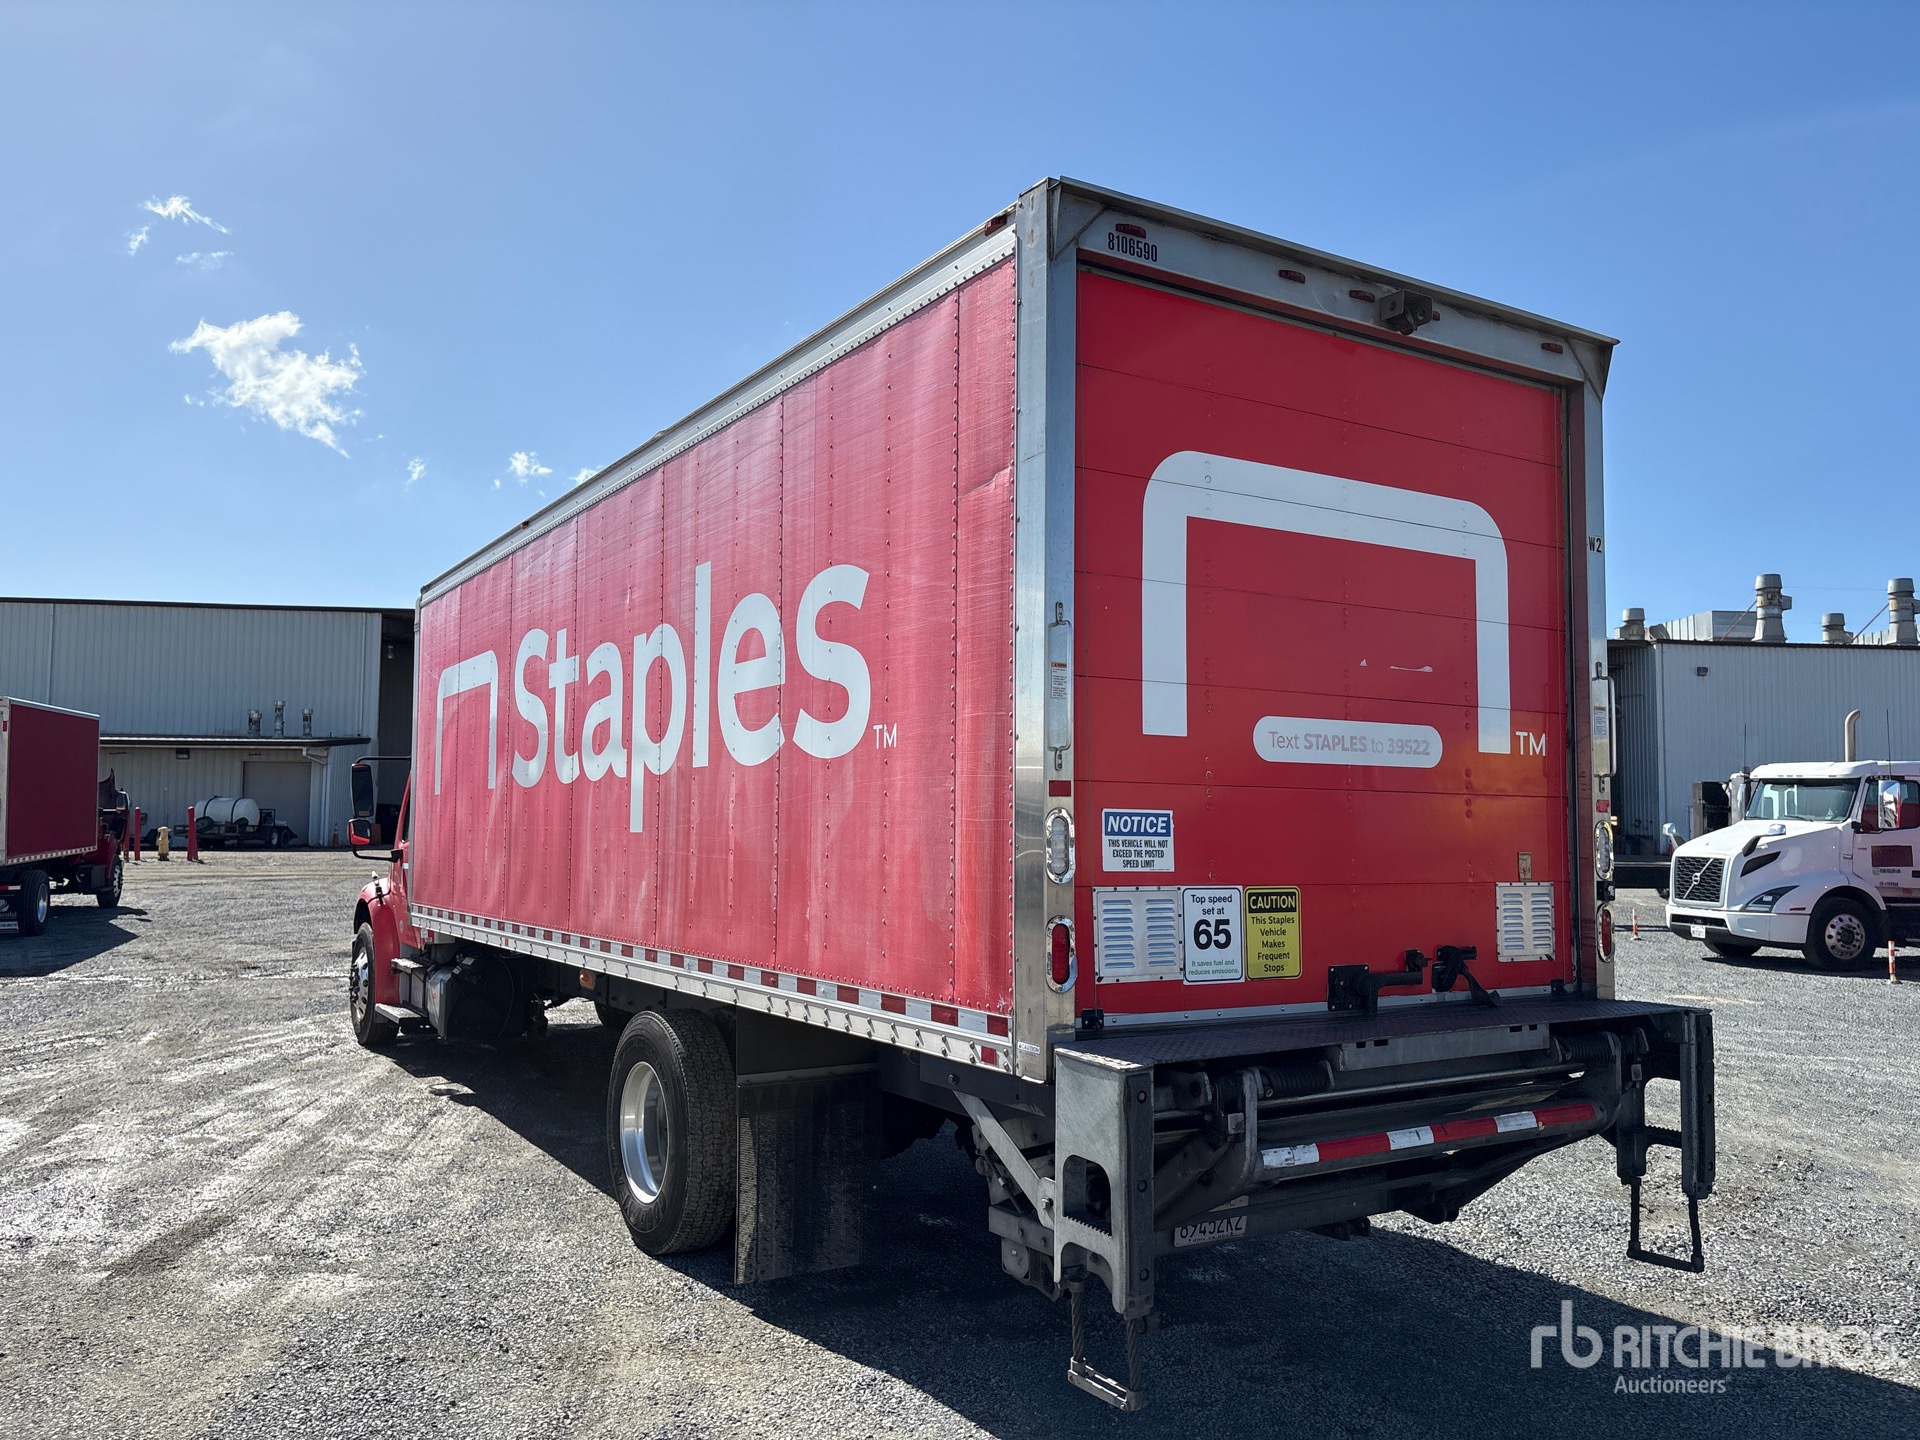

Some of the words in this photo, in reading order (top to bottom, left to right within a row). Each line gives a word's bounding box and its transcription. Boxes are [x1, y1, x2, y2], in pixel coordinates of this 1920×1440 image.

[1108, 232, 1157, 262] 8106590
[512, 561, 871, 833] Staples
[873, 723, 897, 750] TM
[1268, 731, 1299, 749] Text
[1304, 733, 1366, 752] STAPLES
[1371, 739, 1384, 753] to
[1387, 738, 1430, 755] 39522
[1515, 731, 1546, 757] TM
[1108, 816, 1167, 833] NOTICE
[1108, 839, 1120, 847] THIS
[1122, 839, 1142, 847] VEHICLE
[1144, 840, 1156, 848] WILL
[1158, 840, 1168, 848] NOT
[1145, 850, 1164, 858] POSTED
[1123, 860, 1139, 868] SPEED
[1141, 860, 1155, 868] LIMIT
[1191, 895, 1206, 905] Top
[1208, 894, 1232, 904] speed
[1250, 895, 1295, 909] CAUTION
[1202, 907, 1214, 915] set
[1251, 916, 1266, 924] This
[1269, 915, 1295, 925] Staples
[1194, 919, 1231, 950] 65
[1260, 928, 1286, 936] Vehicle
[1262, 939, 1285, 948] Makes
[1258, 952, 1290, 961] Frequent
[1264, 964, 1284, 973] Stops
